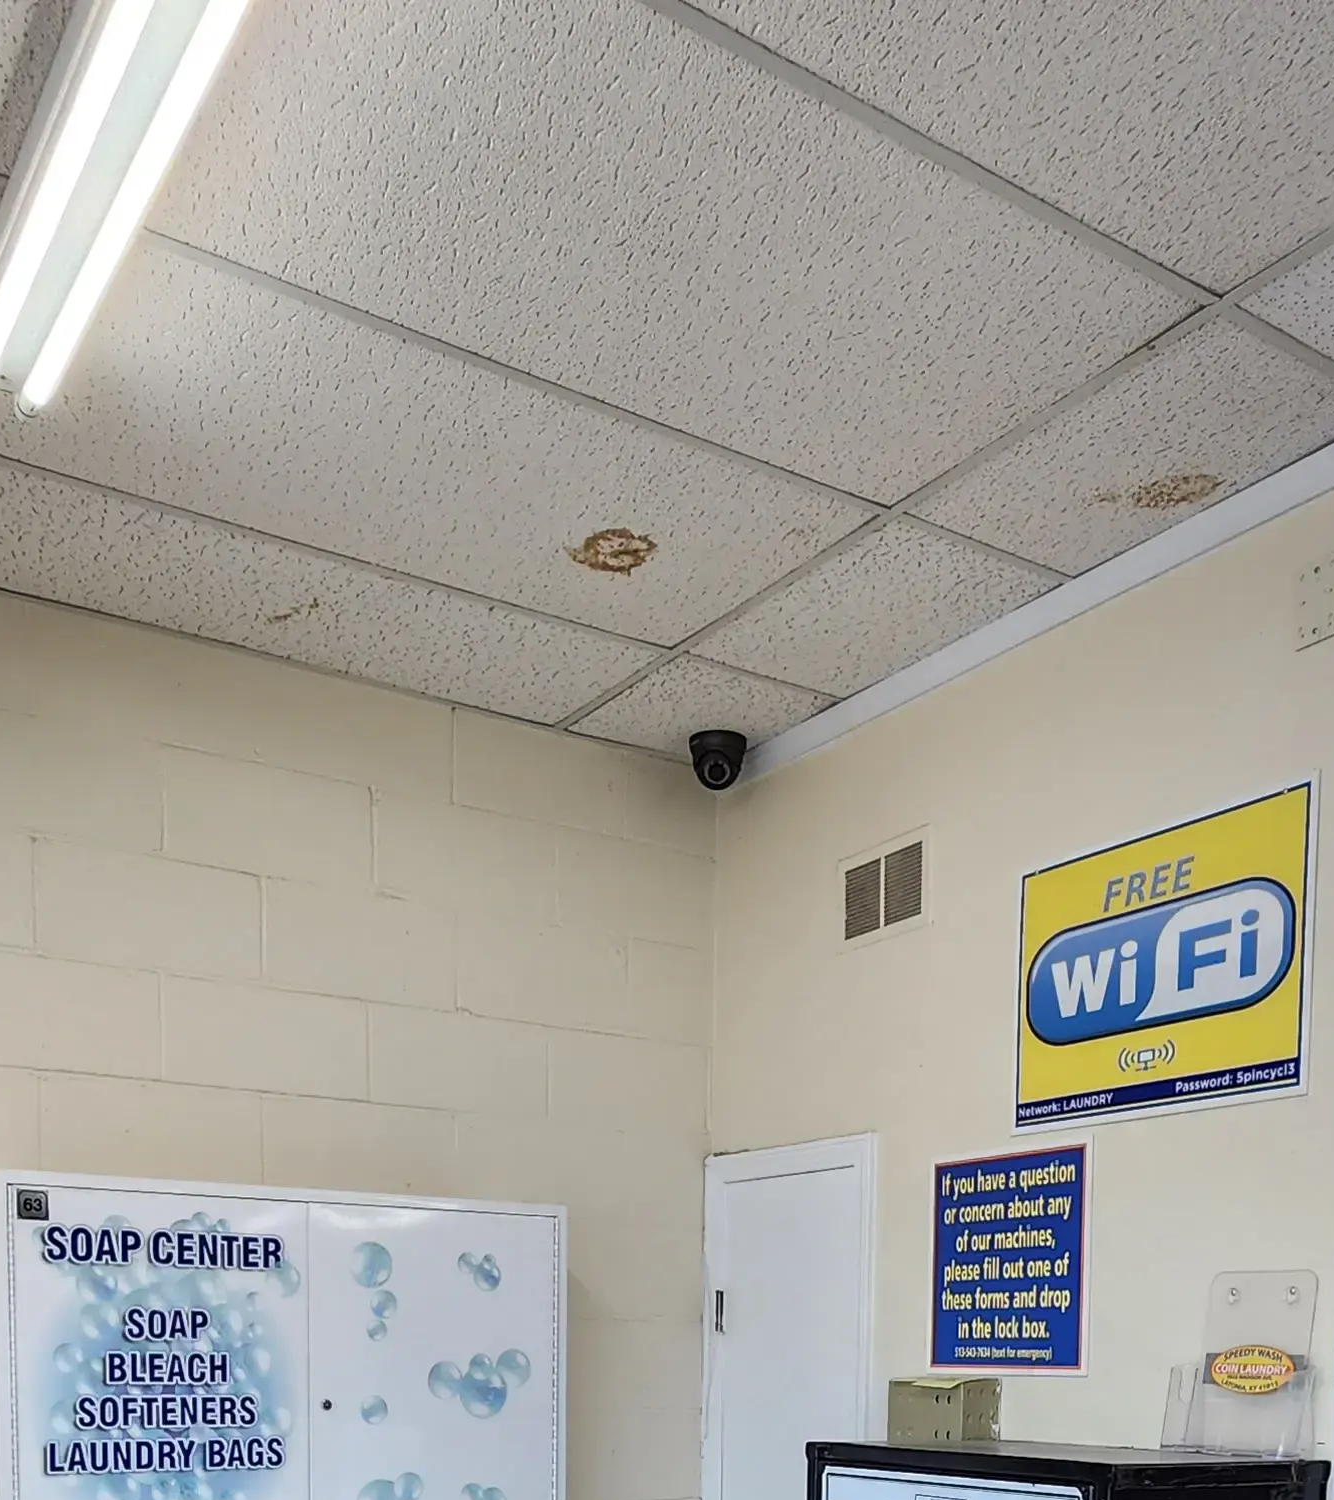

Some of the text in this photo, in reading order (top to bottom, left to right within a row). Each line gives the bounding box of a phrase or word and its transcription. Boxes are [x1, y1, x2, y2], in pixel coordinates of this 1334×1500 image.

[1102, 855, 1195, 913] FREE
[1018, 1102, 1061, 1119] Network:
[1063, 1092, 1114, 1112] LAUNDRY
[1175, 1074, 1234, 1094] Password:
[941, 1160, 1076, 1201] If you have a question
[23, 1198, 43, 1213] 63
[944, 1195, 1072, 1224] or concern about any
[44, 1225, 283, 1269] SOAP CENTER
[956, 1224, 1056, 1252] of our machines,
[944, 1252, 1070, 1288] please fill out one of
[942, 1284, 1071, 1313] these forms and drop
[125, 1307, 209, 1340] SOAP
[957, 1315, 1050, 1339] in the lock box.
[107, 1352, 229, 1384] BLEACH
[1007, 1346, 1016, 1358] for
[1016, 1346, 1053, 1361] emergency)
[1215, 1363, 1287, 1376] COIN LAUNDRY
[1223, 1348, 1283, 1363] SPEEDY WASH
[77, 1396, 257, 1429] SOFTENERS
[49, 1437, 284, 1473] LAUNDRY BAGS
